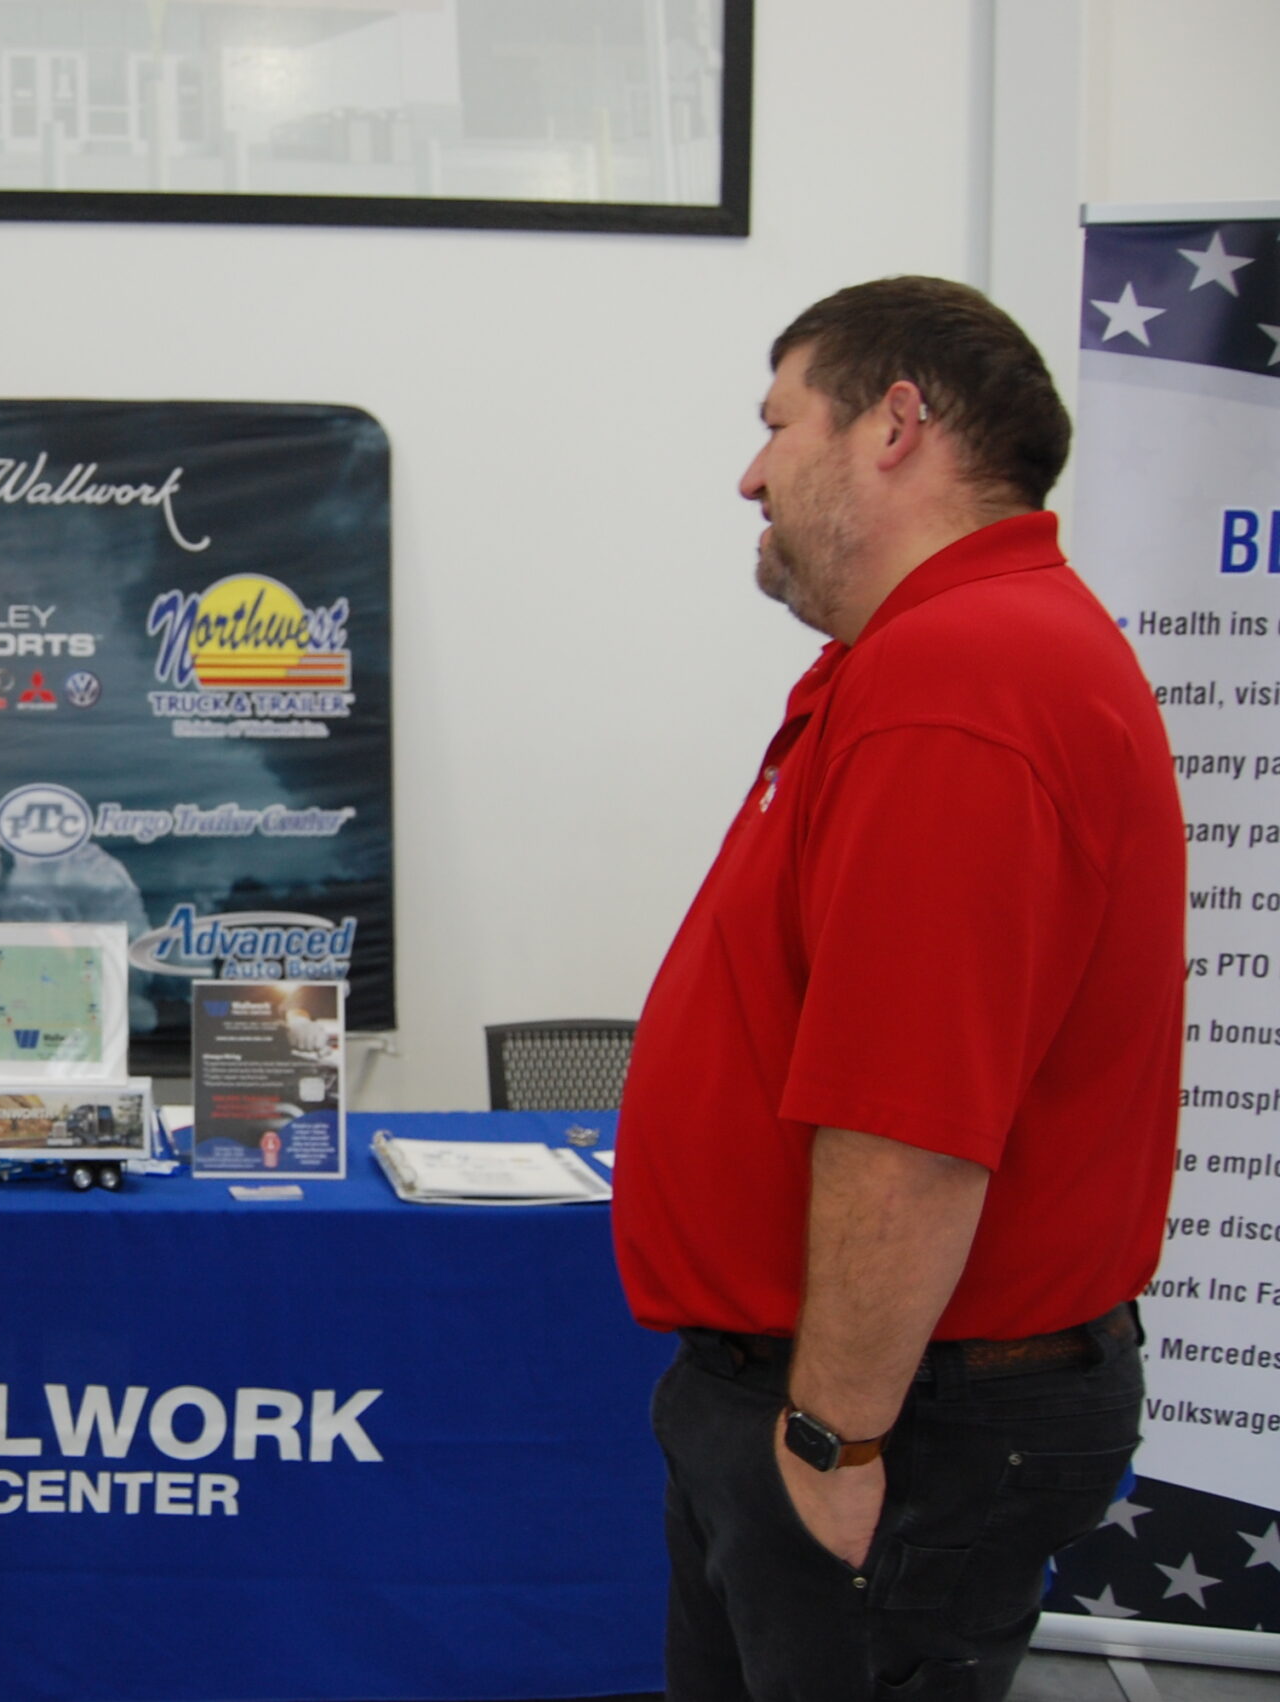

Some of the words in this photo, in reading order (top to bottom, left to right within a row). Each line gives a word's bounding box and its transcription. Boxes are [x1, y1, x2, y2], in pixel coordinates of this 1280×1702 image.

[148, 588, 349, 684] Northwest
[1139, 611, 1221, 636] Health
[1230, 611, 1268, 636] ins
[153, 693, 228, 713] TRUCK
[233, 693, 248, 713] &
[252, 693, 350, 715] TRAILER
[1152, 681, 1223, 709] ental,
[98, 803, 170, 841] Fargo
[174, 804, 257, 835] Trailer
[261, 804, 346, 835] Center
[1189, 886, 1242, 910] with
[156, 905, 353, 957] Advanced
[224, 961, 281, 977] Auto
[288, 961, 349, 979] Body
[1218, 953, 1269, 978] PTO
[1209, 1277, 1248, 1303] Inc
